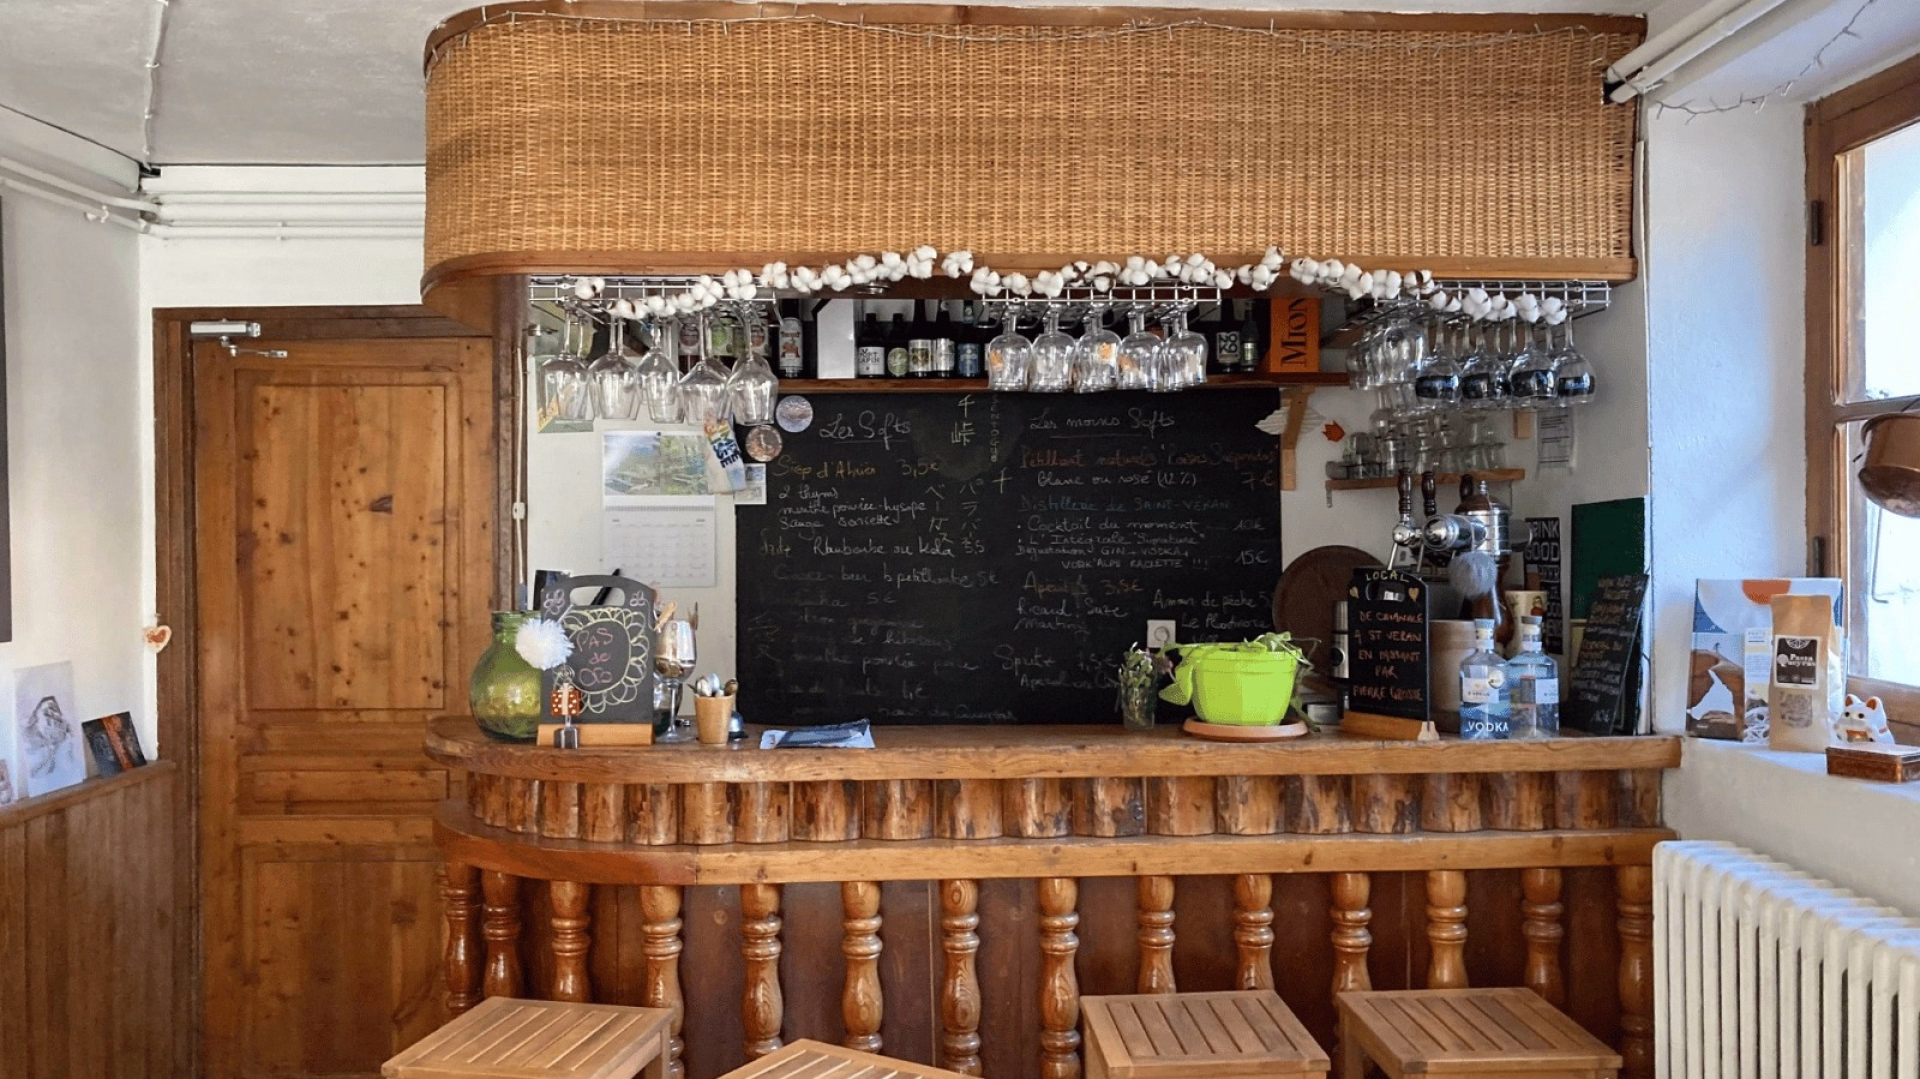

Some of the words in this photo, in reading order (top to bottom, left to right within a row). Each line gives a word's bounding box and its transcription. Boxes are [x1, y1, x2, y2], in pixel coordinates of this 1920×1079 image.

[819, 413, 854, 439] Les
[858, 410, 911, 450] Softs
[1030, 408, 1057, 430] Les
[1066, 415, 1121, 428] moins
[1127, 407, 1176, 439] Softs
[1037, 470, 1084, 487] Blanc
[1092, 476, 1111, 485] ou
[1105, 498, 1127, 512] de
[778, 516, 825, 541] Sauge
[1027, 514, 1092, 532] Cocktail
[1099, 516, 1120, 530] du
[1126, 519, 1201, 533] moment
[1526, 520, 1560, 539] RINK
[893, 544, 914, 556] ou
[1524, 541, 1560, 562] GOOD
[1366, 570, 1410, 584] LOCAL
[1201, 590, 1220, 607] de
[1084, 597, 1128, 618] Suze
[1359, 611, 1373, 623] DE
[576, 627, 614, 652] PAS
[1368, 630, 1383, 642] ST
[1386, 630, 1422, 642] VERAN
[589, 652, 611, 664] de
[1358, 649, 1373, 661] EN
[1374, 665, 1399, 679] PAR
[1353, 685, 1387, 701] PIERRE
[1389, 686, 1424, 702] GROSSE
[1468, 721, 1510, 733] VODKA
